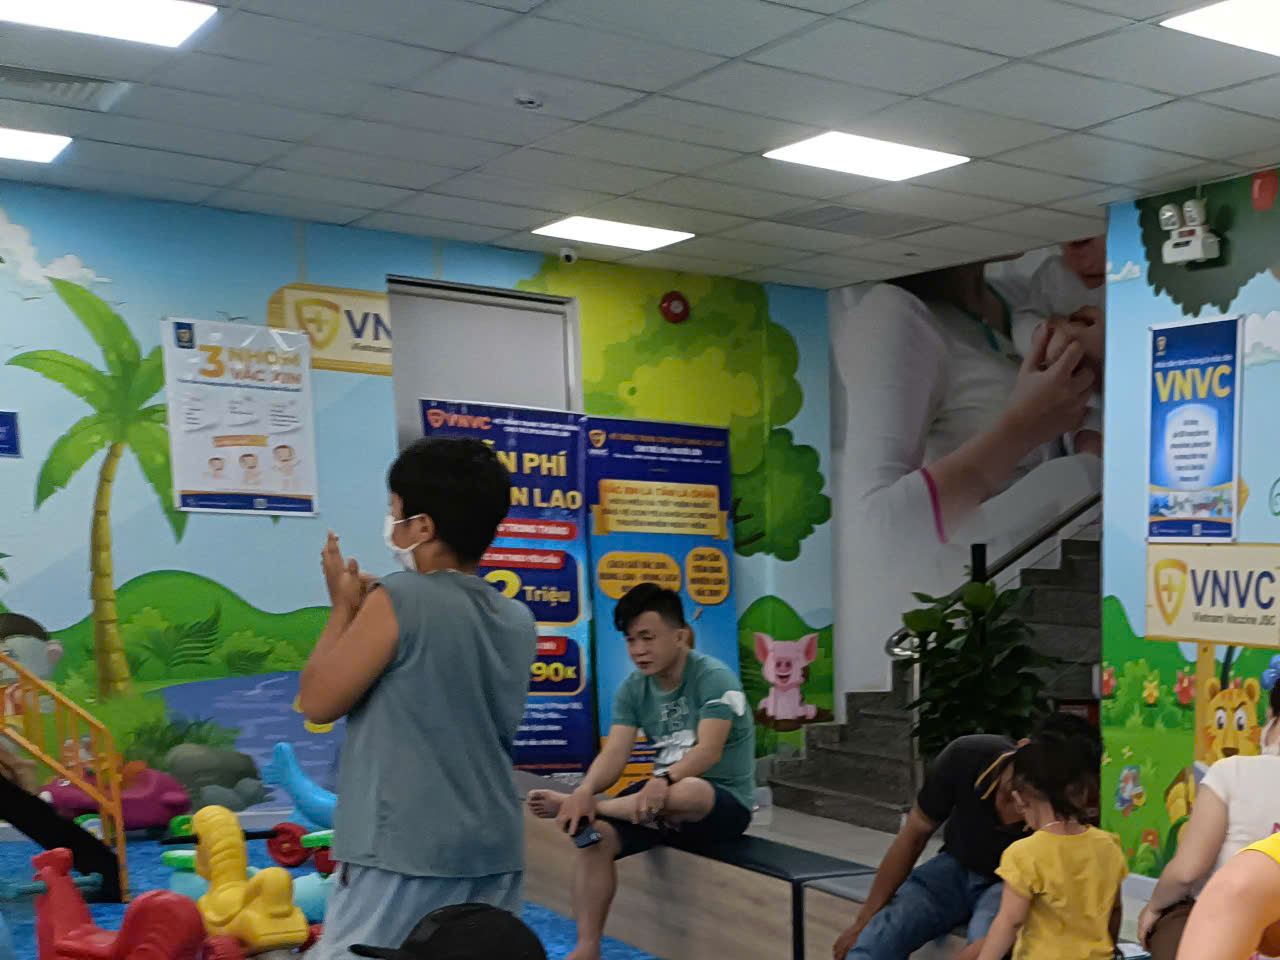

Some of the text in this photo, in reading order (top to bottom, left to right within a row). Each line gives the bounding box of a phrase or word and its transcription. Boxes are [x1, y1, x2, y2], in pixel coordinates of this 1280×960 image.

[343, 309, 392, 341] VN
[199, 344, 225, 378] 3
[1154, 364, 1232, 403] VNVC
[522, 450, 568, 477] PHÍ
[533, 488, 583, 511] LAO
[1190, 568, 1276, 610] VNVC
